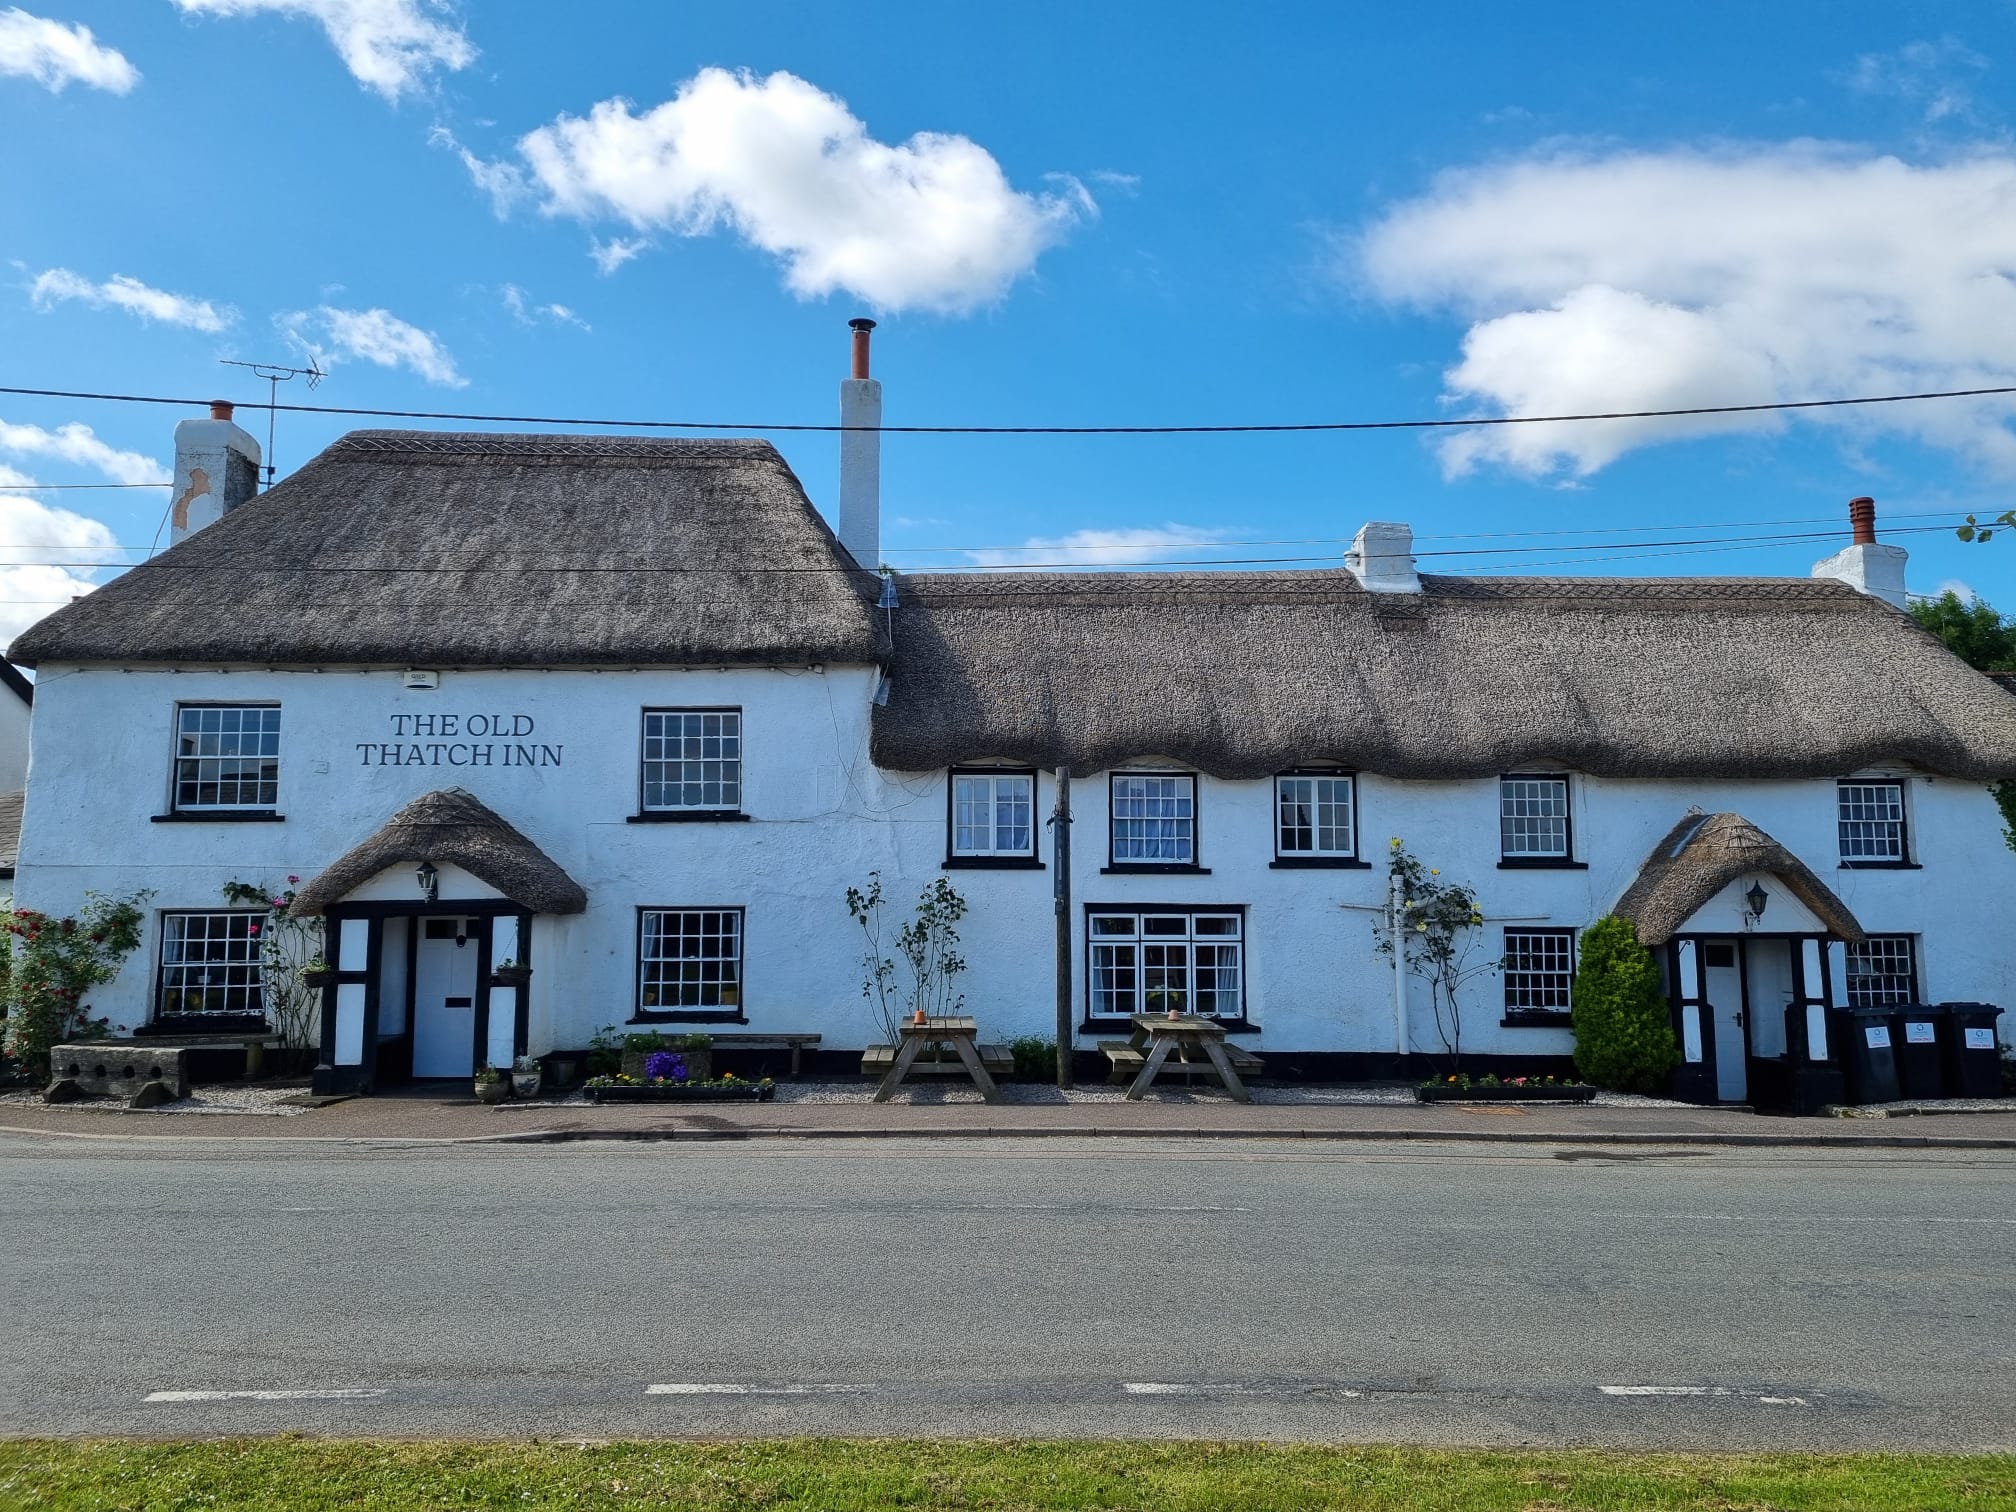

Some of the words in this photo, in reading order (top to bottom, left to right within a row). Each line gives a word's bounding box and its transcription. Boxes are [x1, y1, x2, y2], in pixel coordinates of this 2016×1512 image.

[390, 714, 459, 736] THE
[466, 714, 535, 737] OLD
[355, 743, 494, 766] THATCH
[501, 744, 564, 767] INN
